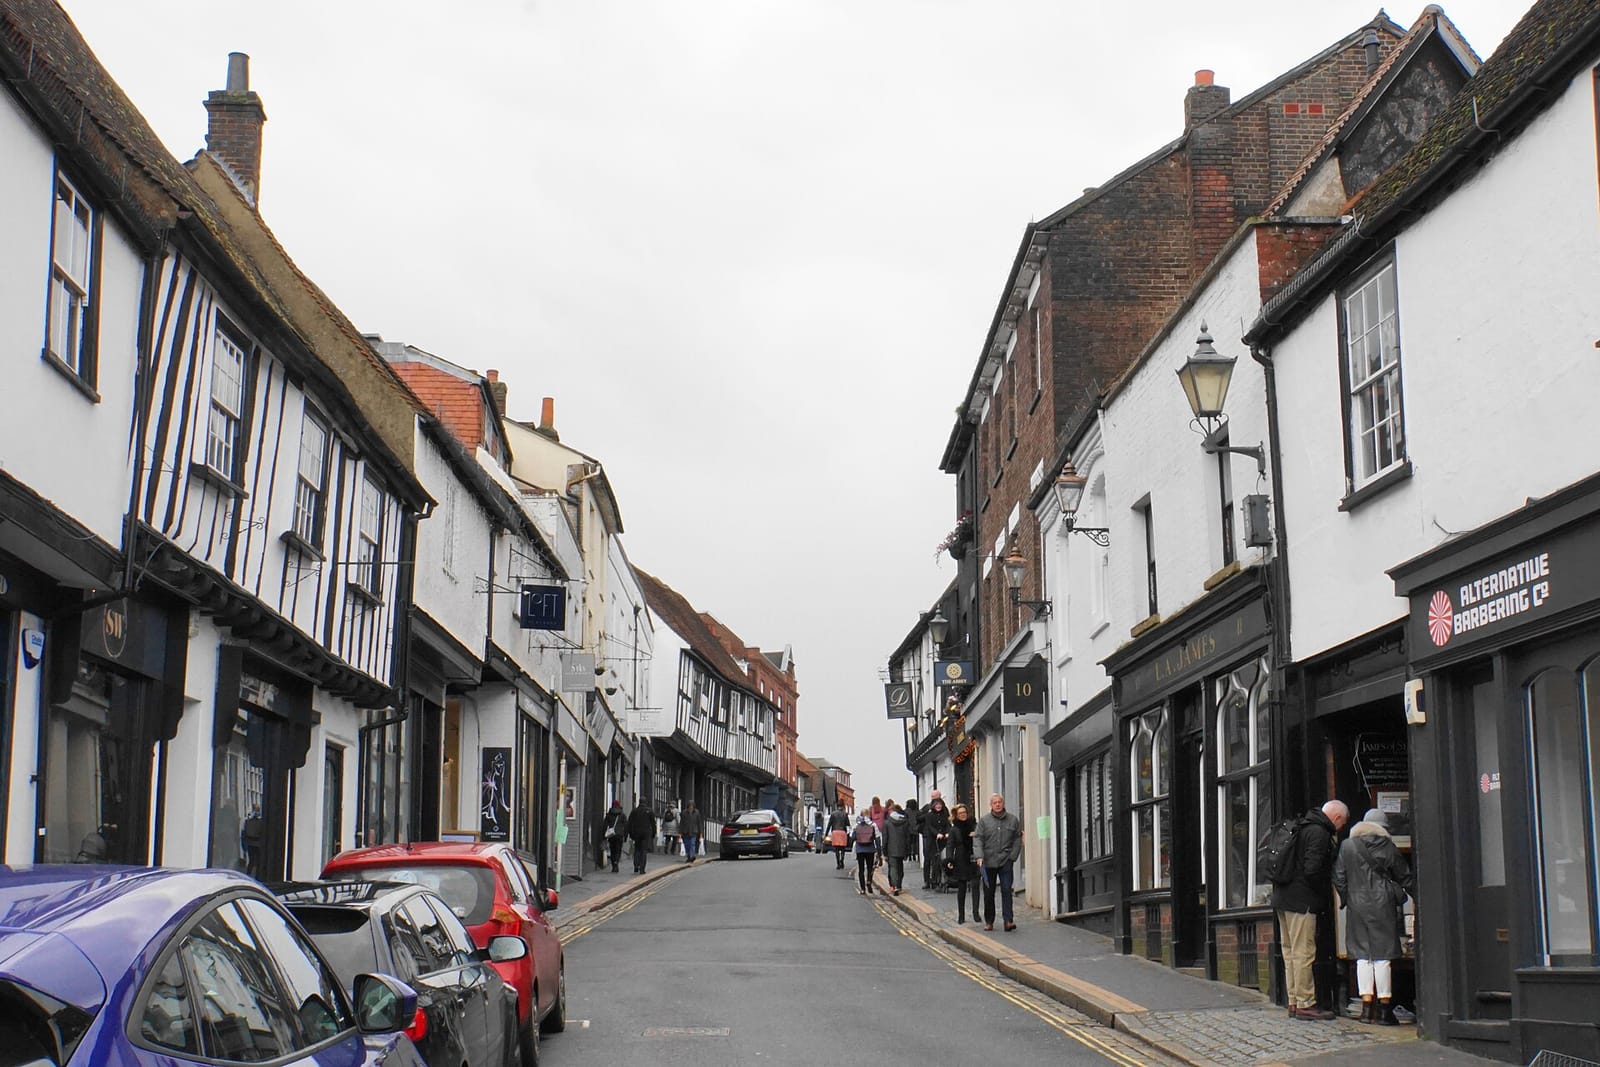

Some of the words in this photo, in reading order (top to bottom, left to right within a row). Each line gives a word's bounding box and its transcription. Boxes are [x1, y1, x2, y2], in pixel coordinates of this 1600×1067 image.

[1460, 553, 1550, 608] ALTERNATIVE
[527, 592, 559, 618] LOFT
[1453, 588, 1530, 636] BARBERING
[1016, 682, 1031, 697] 10
